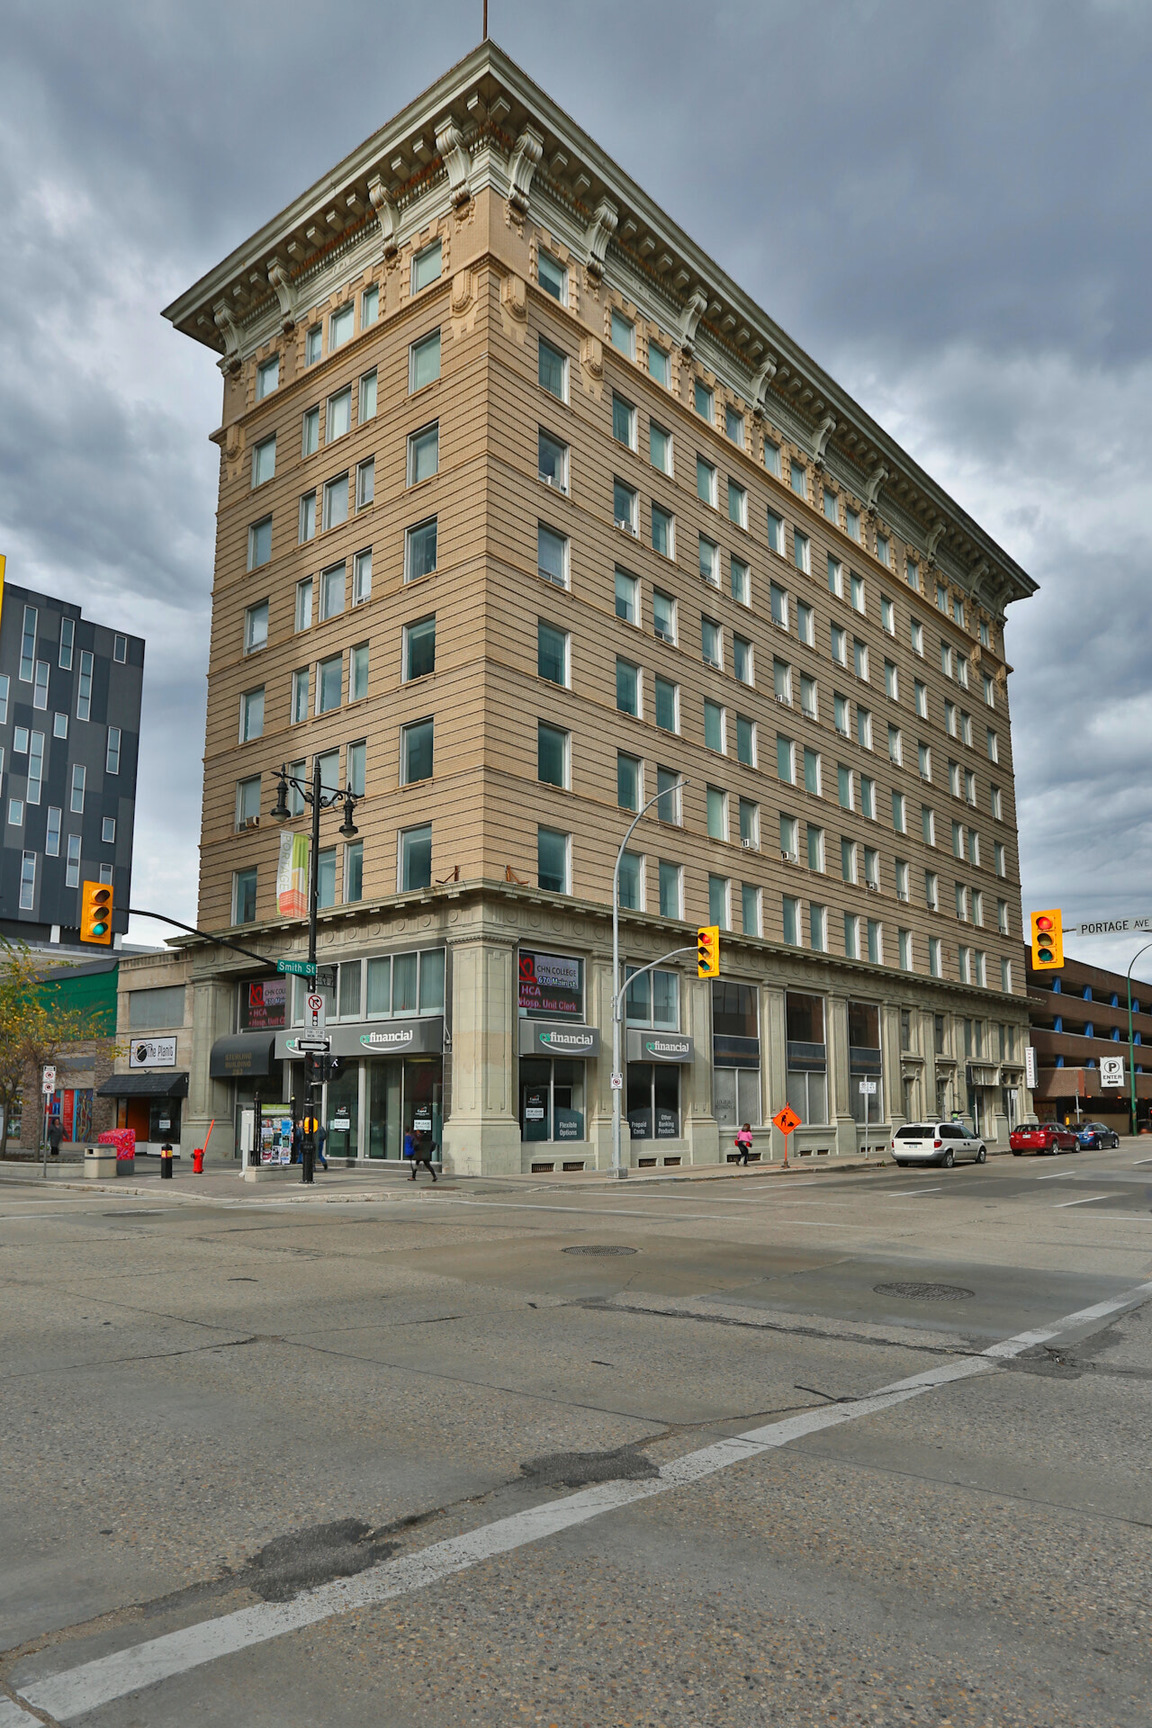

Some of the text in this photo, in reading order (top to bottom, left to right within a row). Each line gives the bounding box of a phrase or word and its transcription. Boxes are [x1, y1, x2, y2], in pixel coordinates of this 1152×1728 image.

[279, 835, 292, 890] PORTAGE
[1081, 919, 1150, 934] PORTAGE AVE
[279, 961, 315, 974] Smith St
[537, 965, 577, 978] CHN COLLEGE
[538, 975, 551, 983] 670
[552, 977, 568, 986] Main
[521, 985, 541, 997] HCA
[520, 996, 577, 1012] Hosp. Unit Clerk
[253, 1008, 268, 1017] HCA
[359, 1029, 413, 1044] csfinancial
[539, 1031, 594, 1046] csfinancial
[645, 1040, 690, 1053] csfinancial
[1108, 1062, 1117, 1072] P
[559, 1121, 577, 1129] Flexible
[631, 1121, 647, 1129] Prepaid
[559, 1129, 577, 1137] Options
